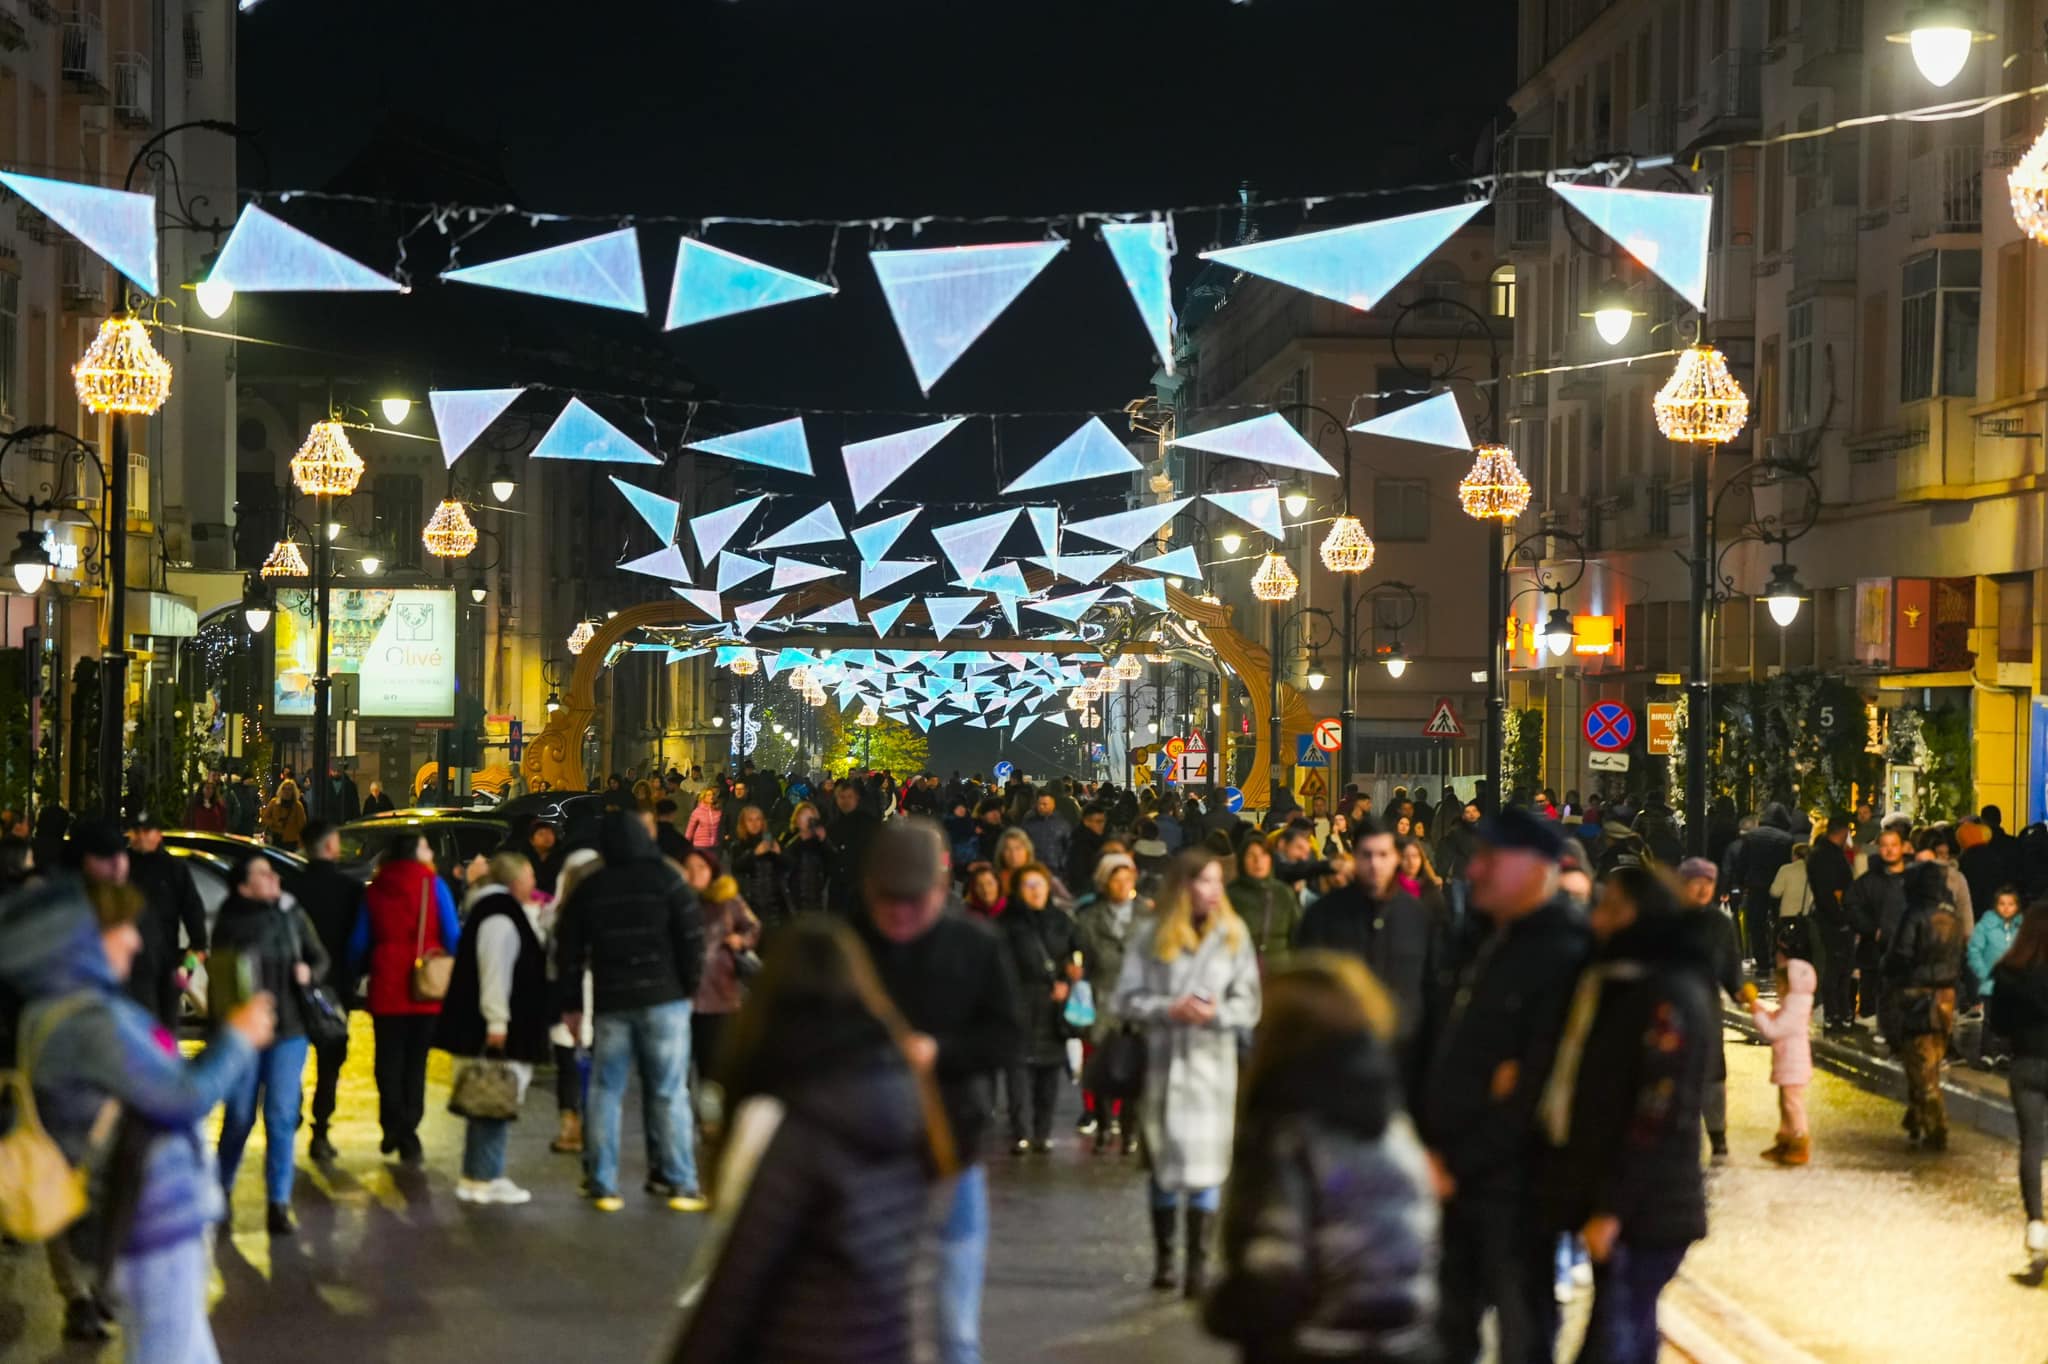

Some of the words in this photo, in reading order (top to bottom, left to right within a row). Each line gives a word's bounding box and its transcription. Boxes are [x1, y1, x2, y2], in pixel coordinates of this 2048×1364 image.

[385, 646, 442, 667] Olivé
[1820, 706, 1834, 727] 5
[1171, 744, 1183, 753] 30
